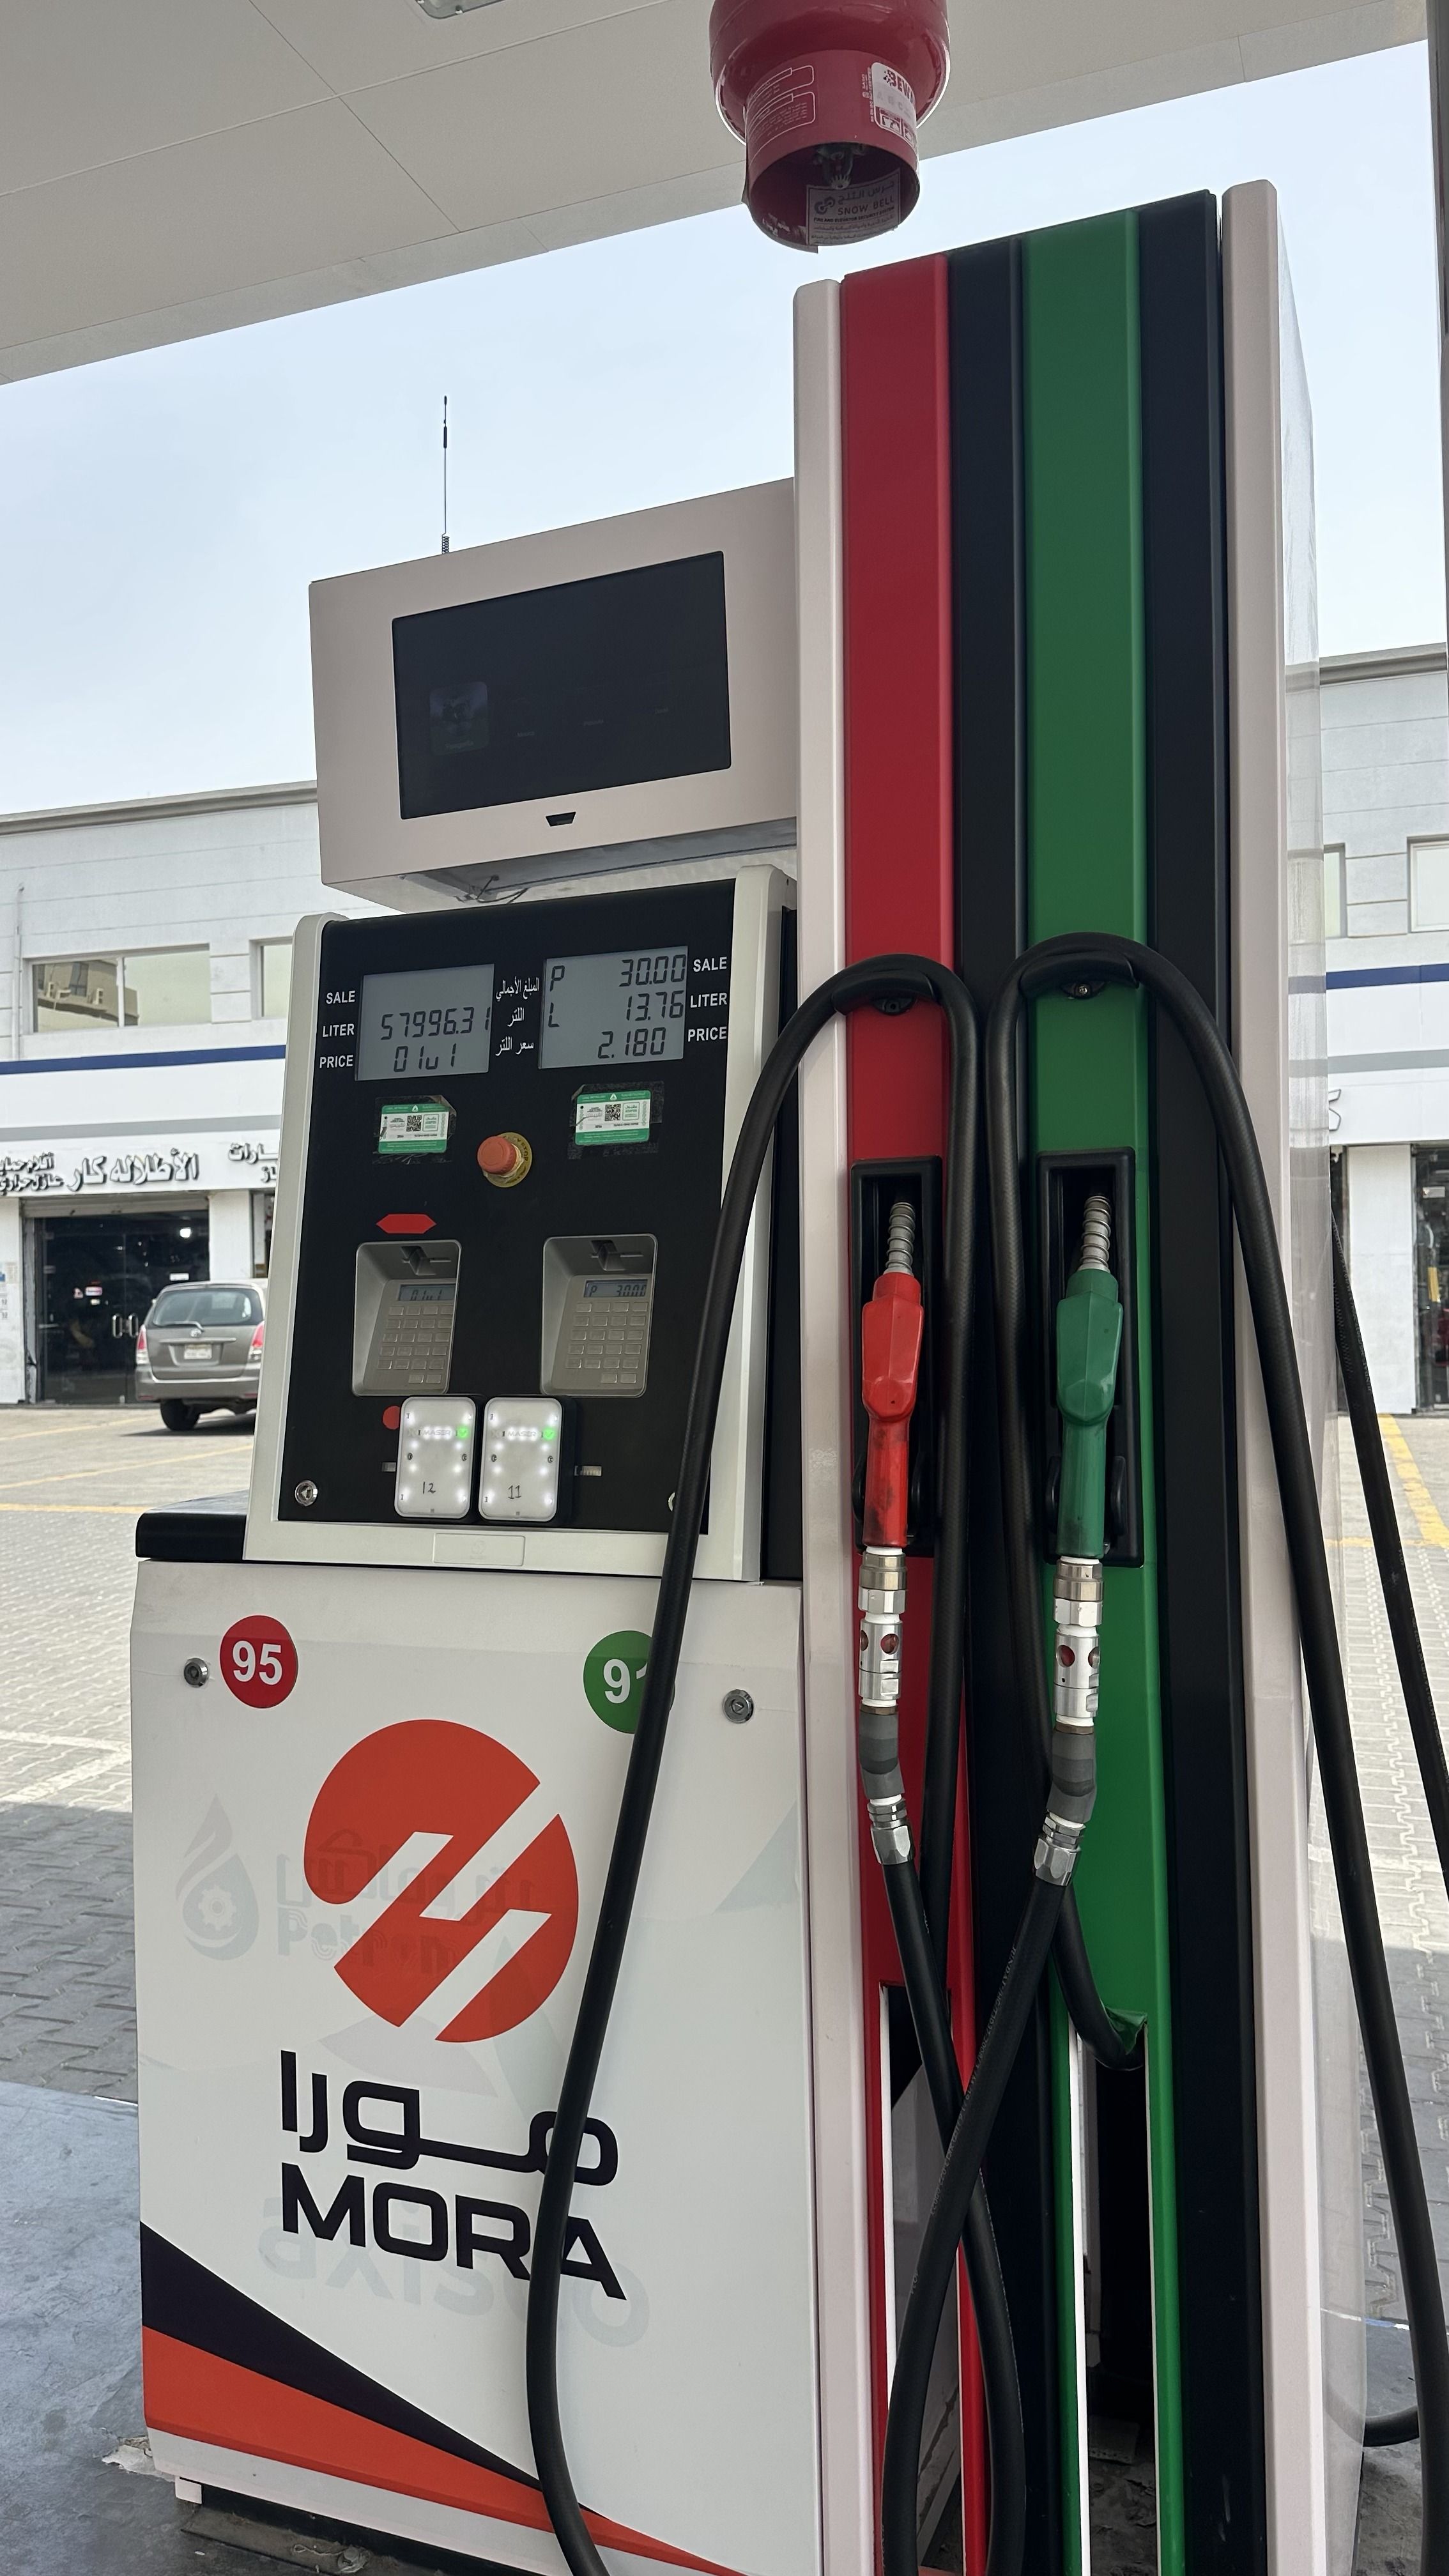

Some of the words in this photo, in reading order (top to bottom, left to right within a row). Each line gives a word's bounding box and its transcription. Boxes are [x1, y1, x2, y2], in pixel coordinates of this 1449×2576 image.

[838, 204, 869, 215] SNOW
[873, 195, 894, 208] BELL
[550, 965, 565, 992] P
[619, 954, 686, 986] 30.00
[693, 956, 727, 972] SALE
[326, 990, 356, 1004] SALE
[523, 977, 540, 1000] المبلغ
[548, 1002, 560, 1027] L
[626, 990, 684, 1021] 13.76
[690, 992, 727, 1008] LITER
[507, 1007, 525, 1027] اللتر
[323, 1023, 355, 1038] LITER
[687, 1026, 727, 1042] PRICE
[495, 1036, 512, 1056] اللتر
[516, 1041, 534, 1055] سعر
[598, 1027, 666, 1059] 2.180
[319, 1055, 353, 1069] PRICE
[66, 1156, 107, 1192] كار
[422, 1482, 436, 1494] 12
[508, 1485, 522, 1499] 11
[232, 1640, 283, 1686] 95
[281, 2050, 618, 2186] مورا
[282, 2162, 627, 2300] MORA
